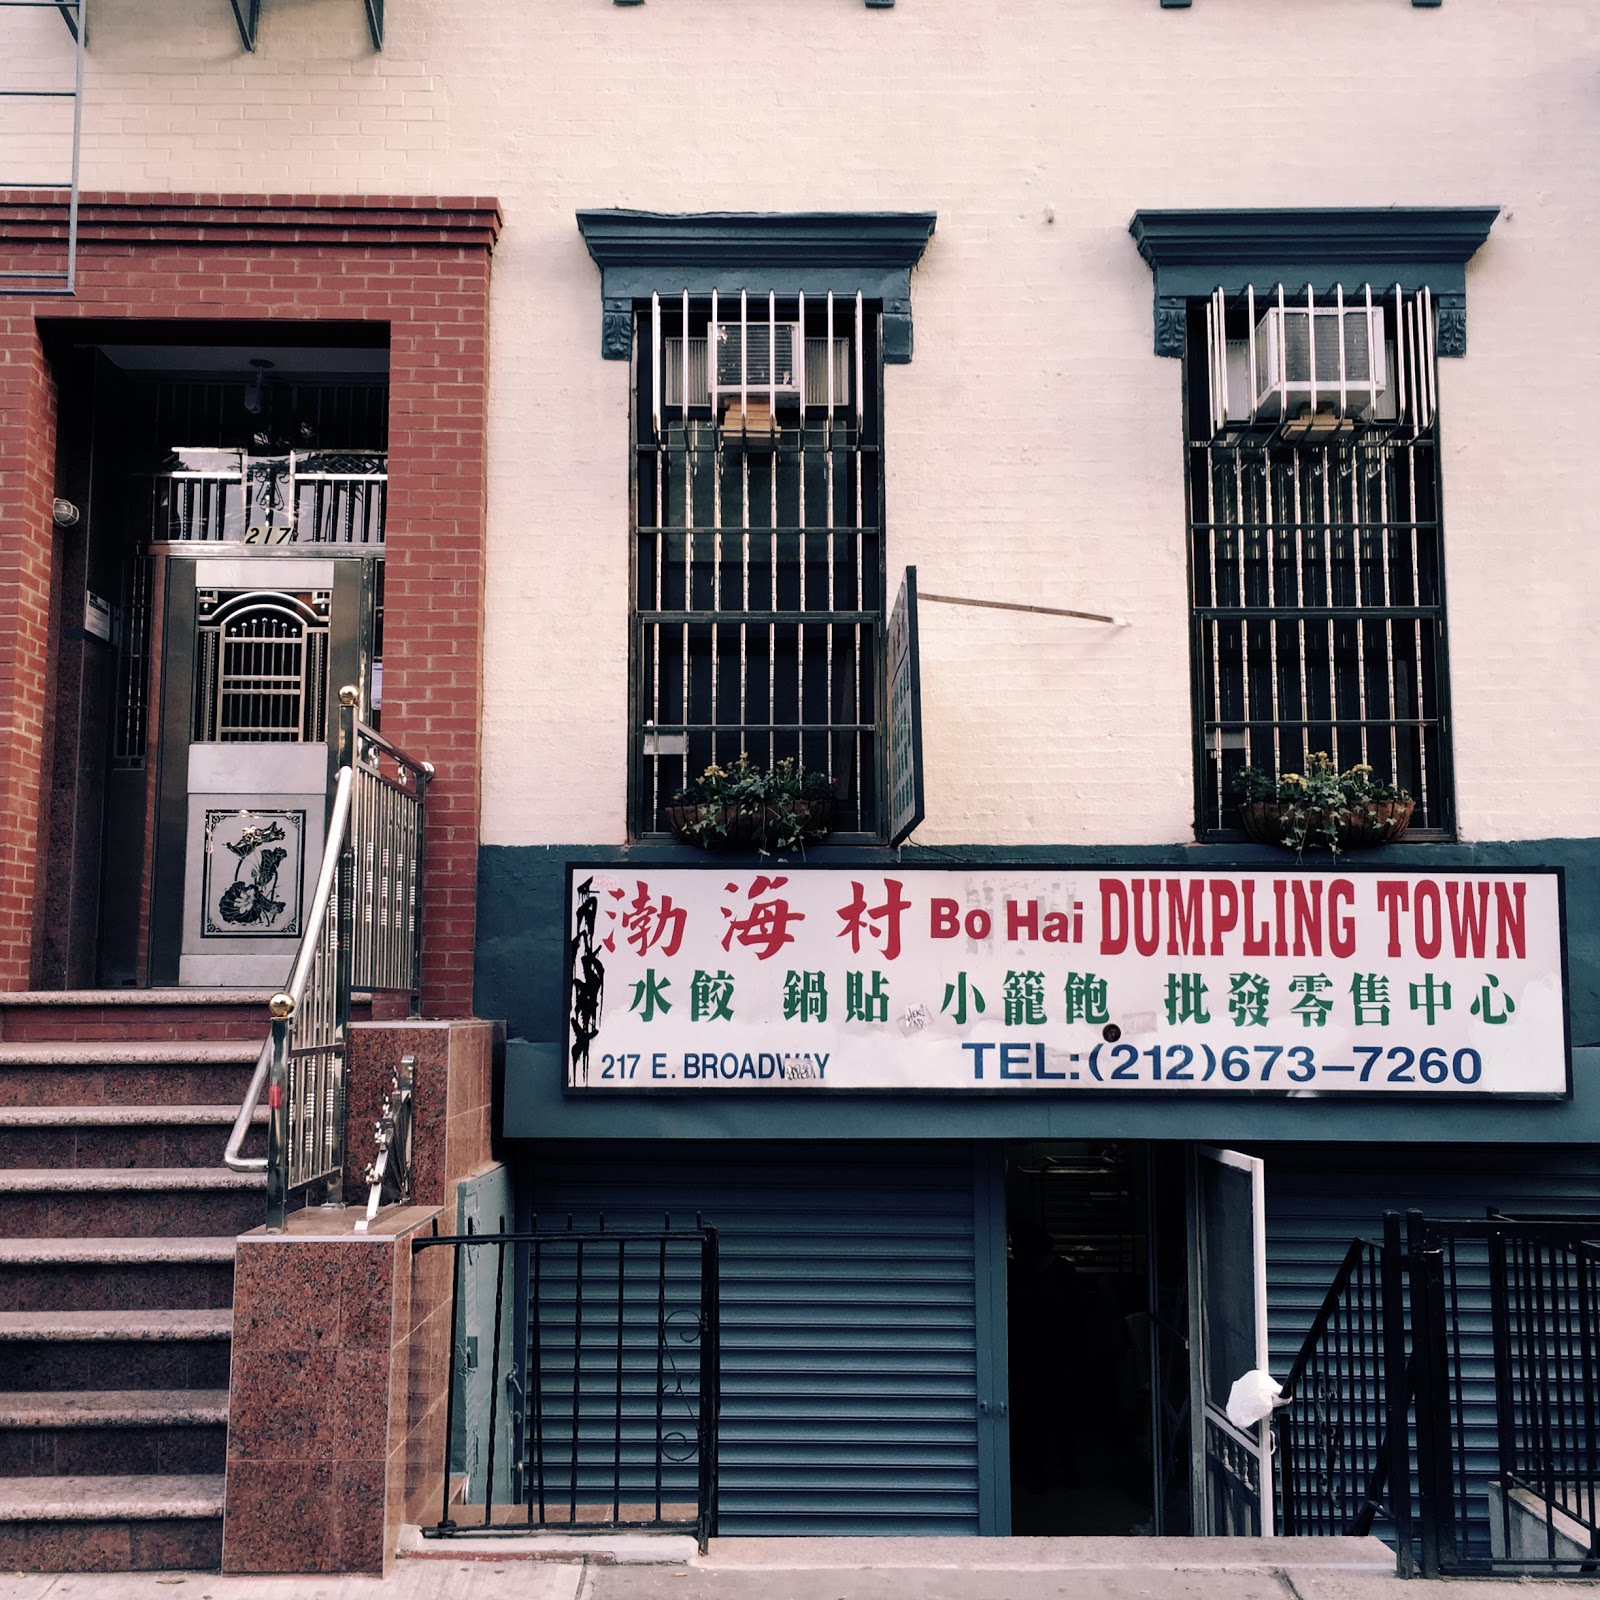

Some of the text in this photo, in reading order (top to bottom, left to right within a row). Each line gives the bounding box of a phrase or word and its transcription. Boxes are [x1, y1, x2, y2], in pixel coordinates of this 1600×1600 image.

[245, 527, 291, 544] 217
[602, 875, 912, 960] 渤海村
[930, 878, 1527, 960] Bo Hai DUMPLING TOWN
[628, 968, 735, 1022] 水餃
[783, 969, 889, 1023] 鍋貼
[1163, 971, 1515, 1027] 批發零售中心
[602, 1053, 640, 1079] 217
[652, 1053, 676, 1079] E.
